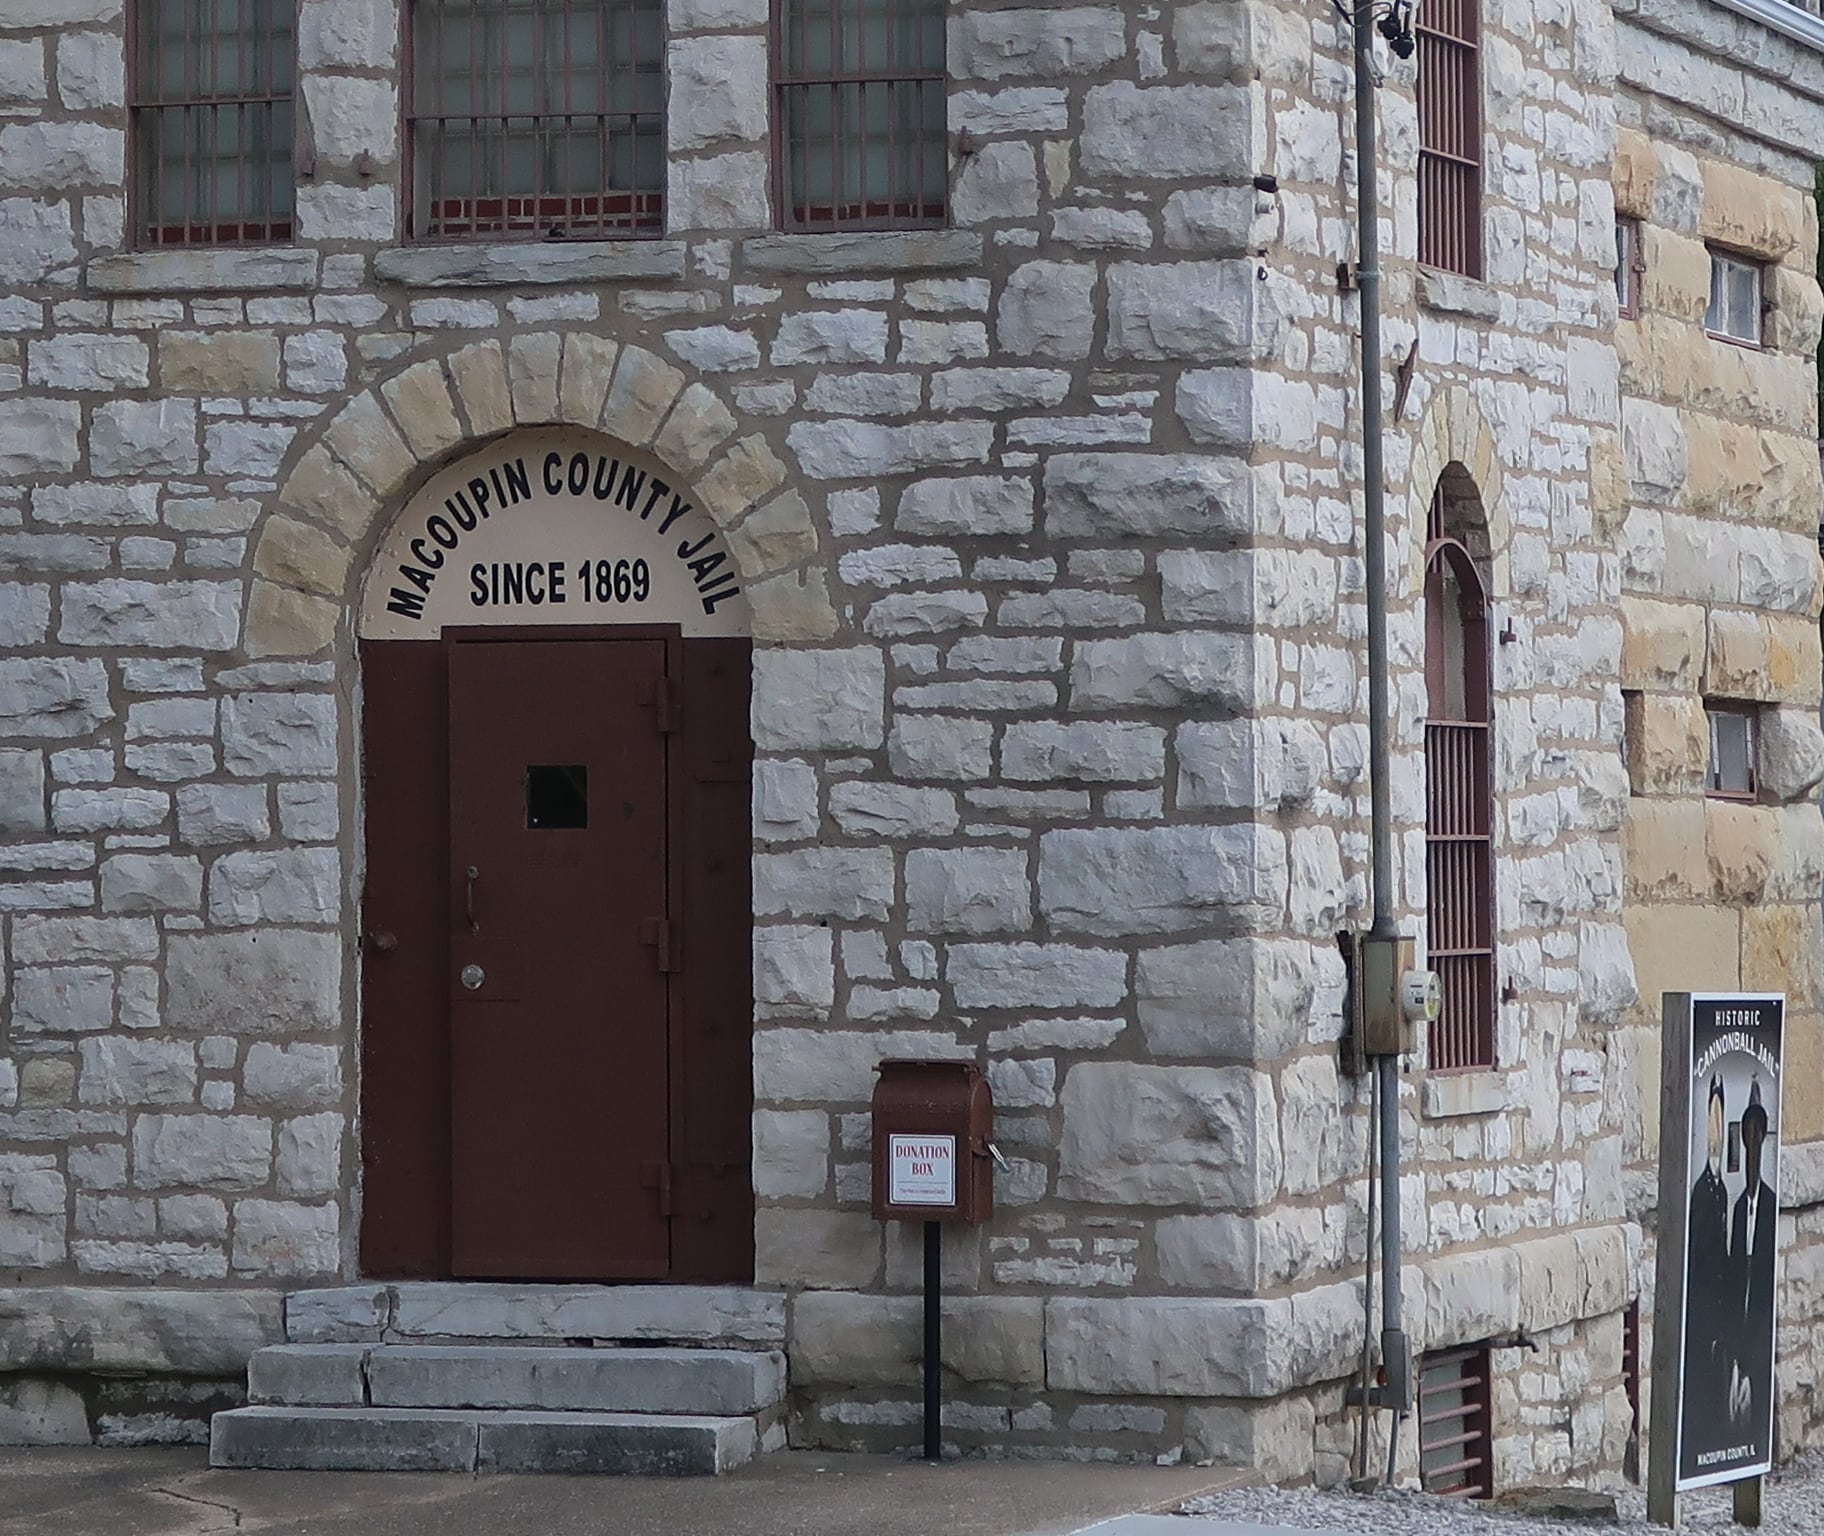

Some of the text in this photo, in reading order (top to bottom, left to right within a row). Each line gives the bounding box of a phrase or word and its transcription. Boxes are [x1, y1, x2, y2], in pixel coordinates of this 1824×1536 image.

[387, 452, 740, 620] MACOUPIN COUNTY JAIL
[471, 558, 650, 605] SINCE 1869
[1715, 1010, 1761, 1026] HISTORIC
[896, 1145, 950, 1159] DONATION
[912, 1162, 934, 1176] BOX
